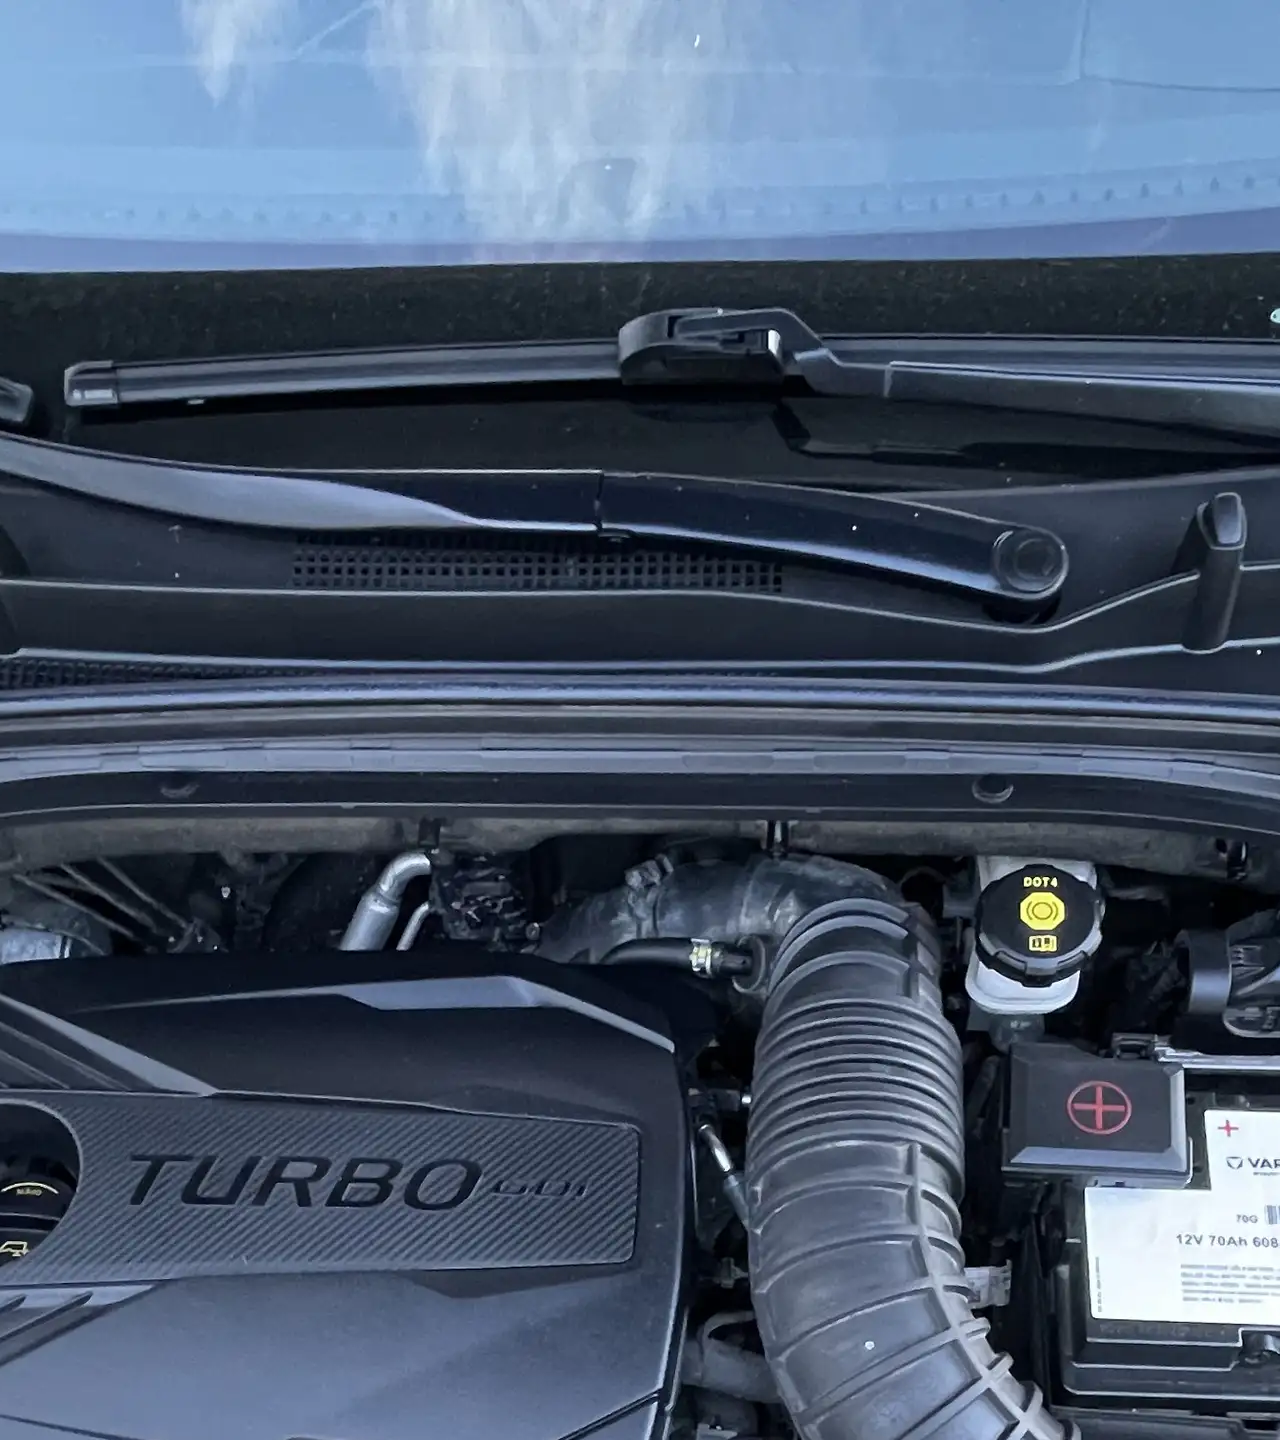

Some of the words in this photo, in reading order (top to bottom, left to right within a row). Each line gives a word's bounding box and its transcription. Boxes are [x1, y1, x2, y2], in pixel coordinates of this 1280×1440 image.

[129, 1154, 483, 1211] TURBO
[1176, 1233, 1203, 1246] 12V
[1209, 1234, 1248, 1247] 70Ah
